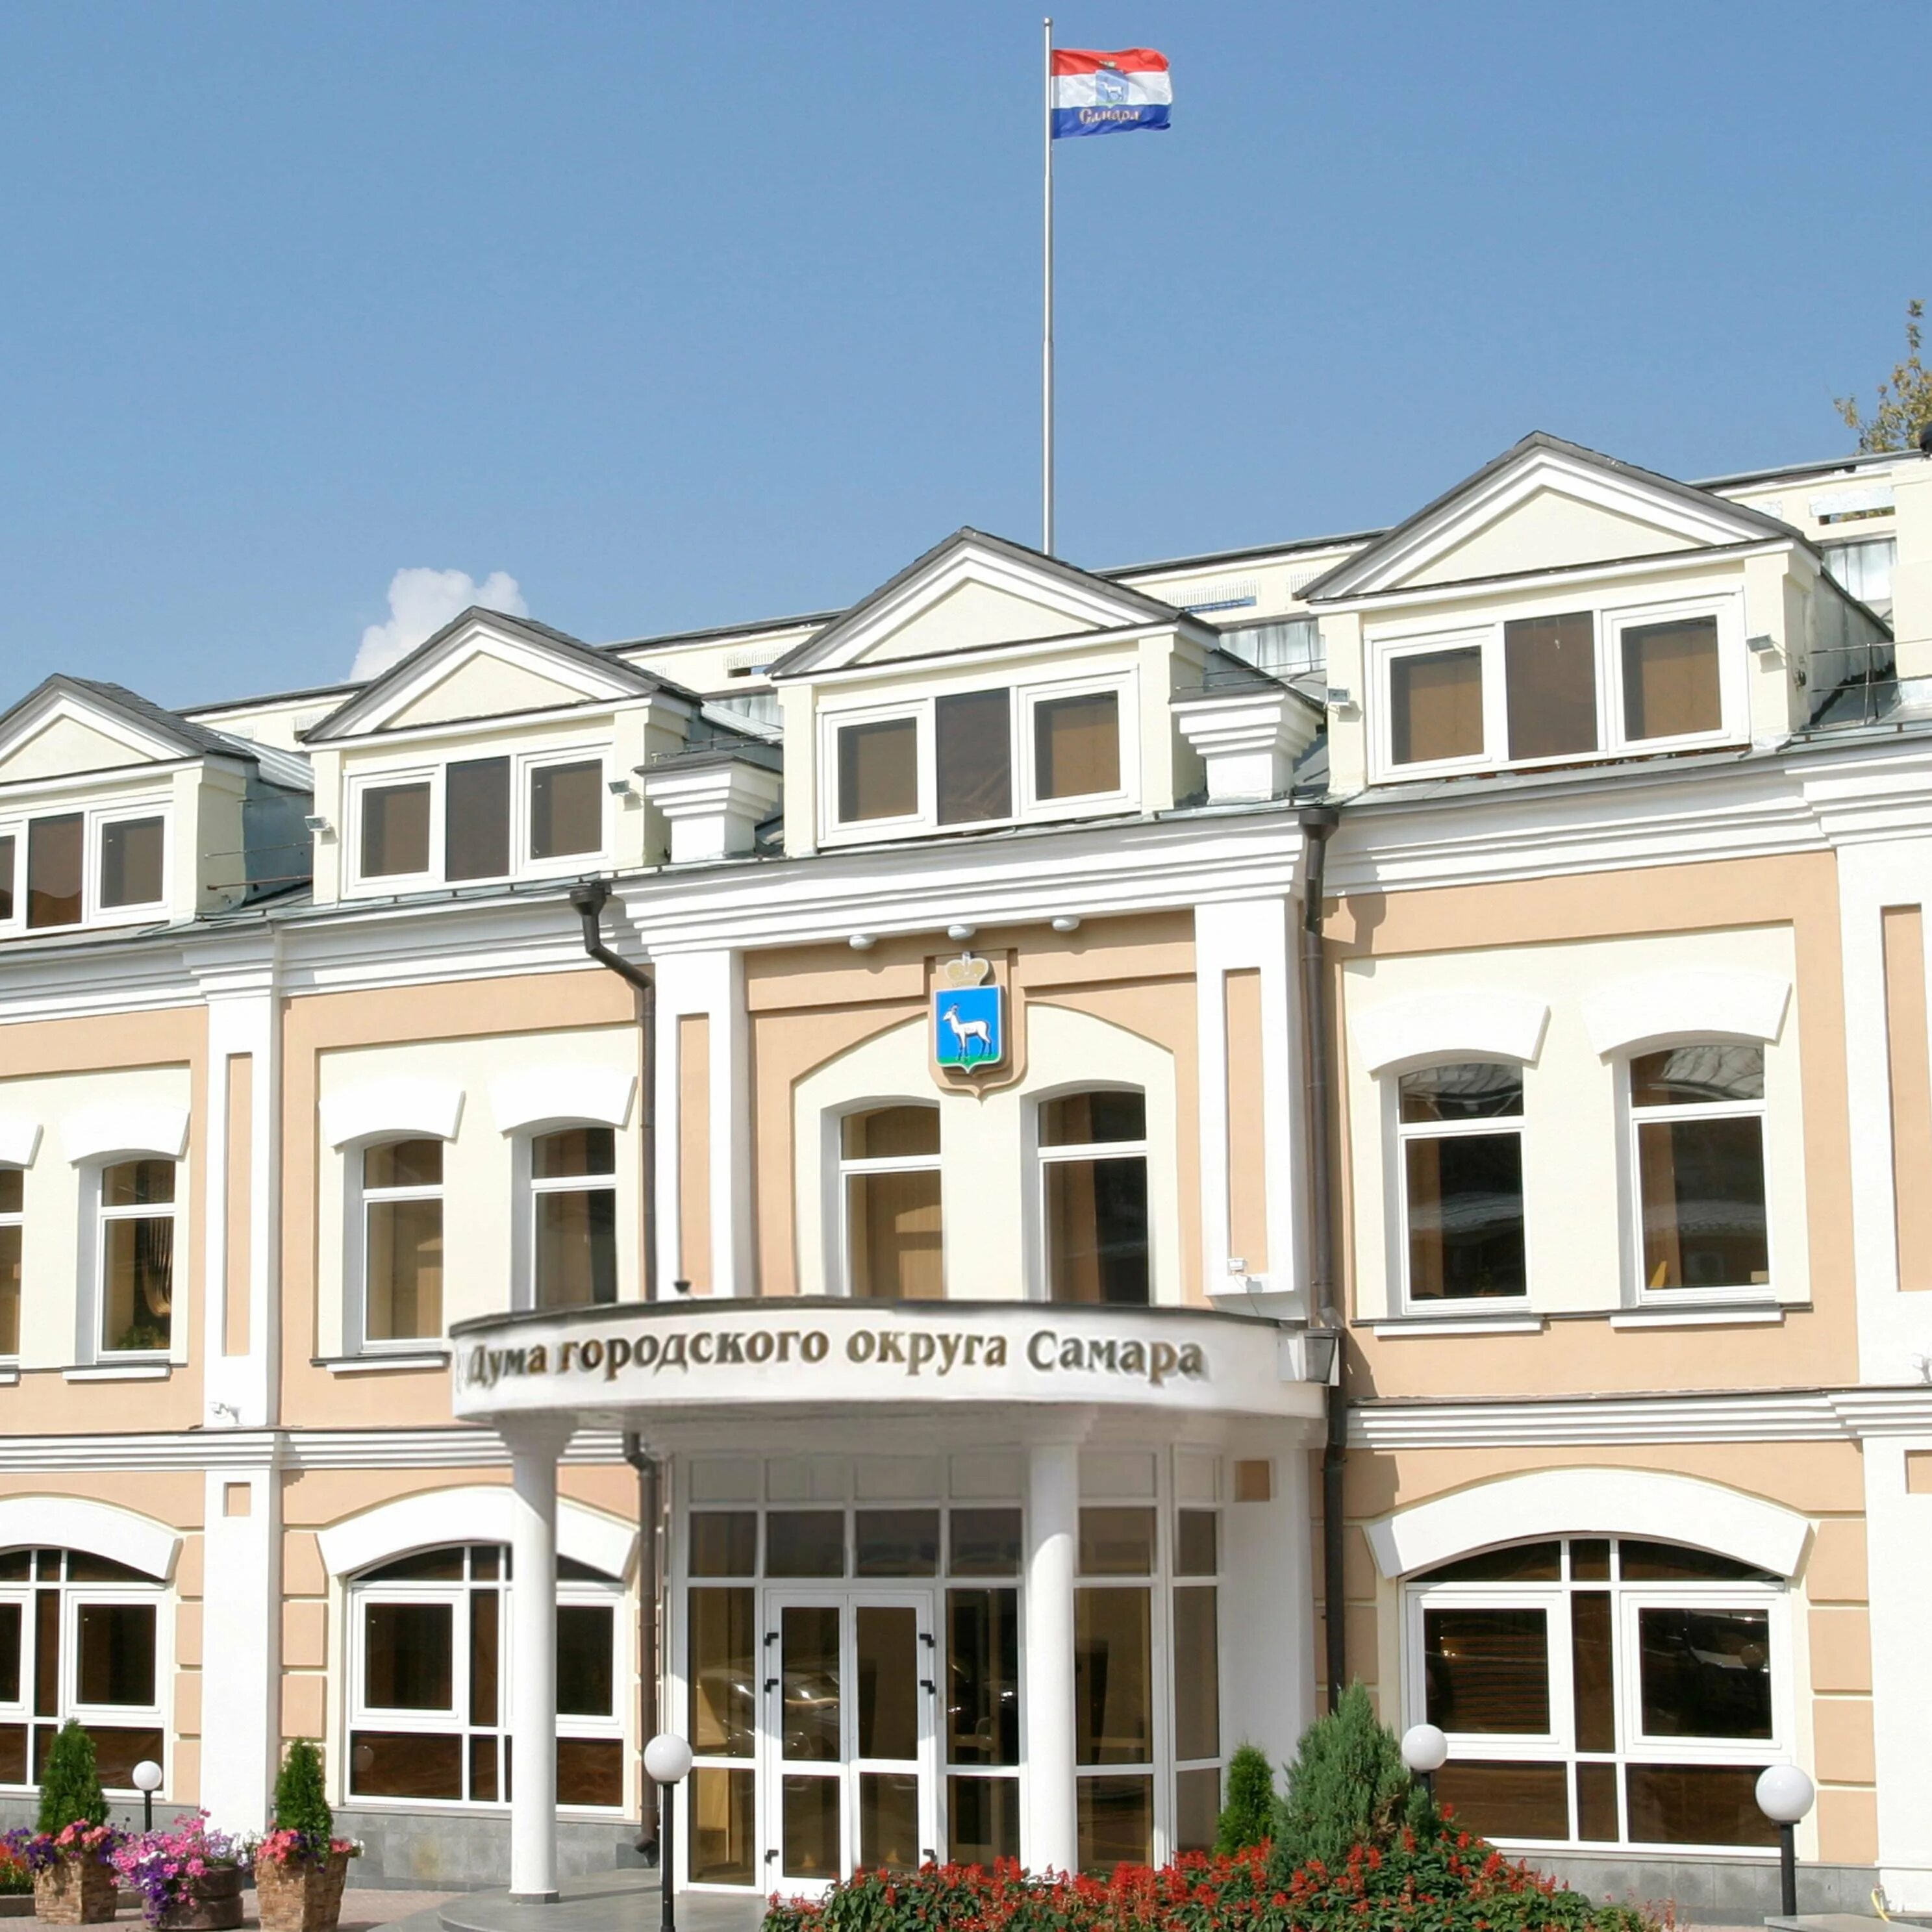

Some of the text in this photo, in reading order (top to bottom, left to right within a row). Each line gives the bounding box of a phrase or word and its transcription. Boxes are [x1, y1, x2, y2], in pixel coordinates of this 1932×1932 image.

[466, 1329, 1206, 1390] Дума городского округа Самара
